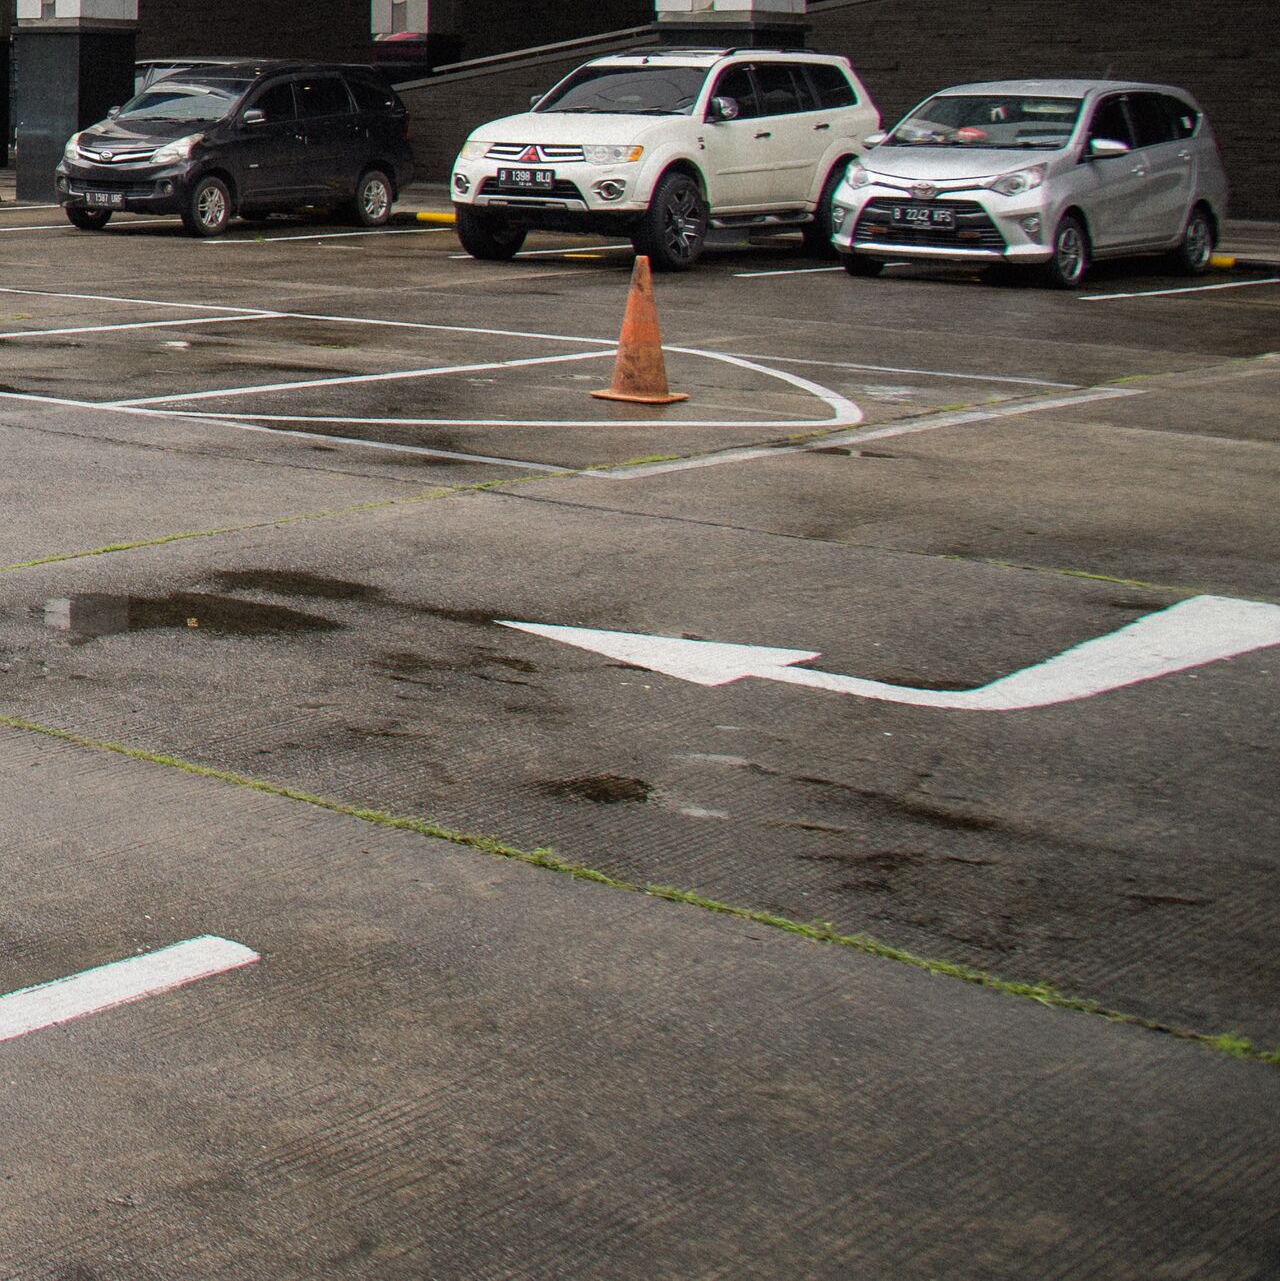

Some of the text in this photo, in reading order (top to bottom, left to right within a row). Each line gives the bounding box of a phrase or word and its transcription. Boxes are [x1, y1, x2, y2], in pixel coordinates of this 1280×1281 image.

[500, 170, 506, 181] B
[512, 171, 531, 181] 1398
[894, 208, 900, 219] B
[905, 208, 930, 221] 2242
